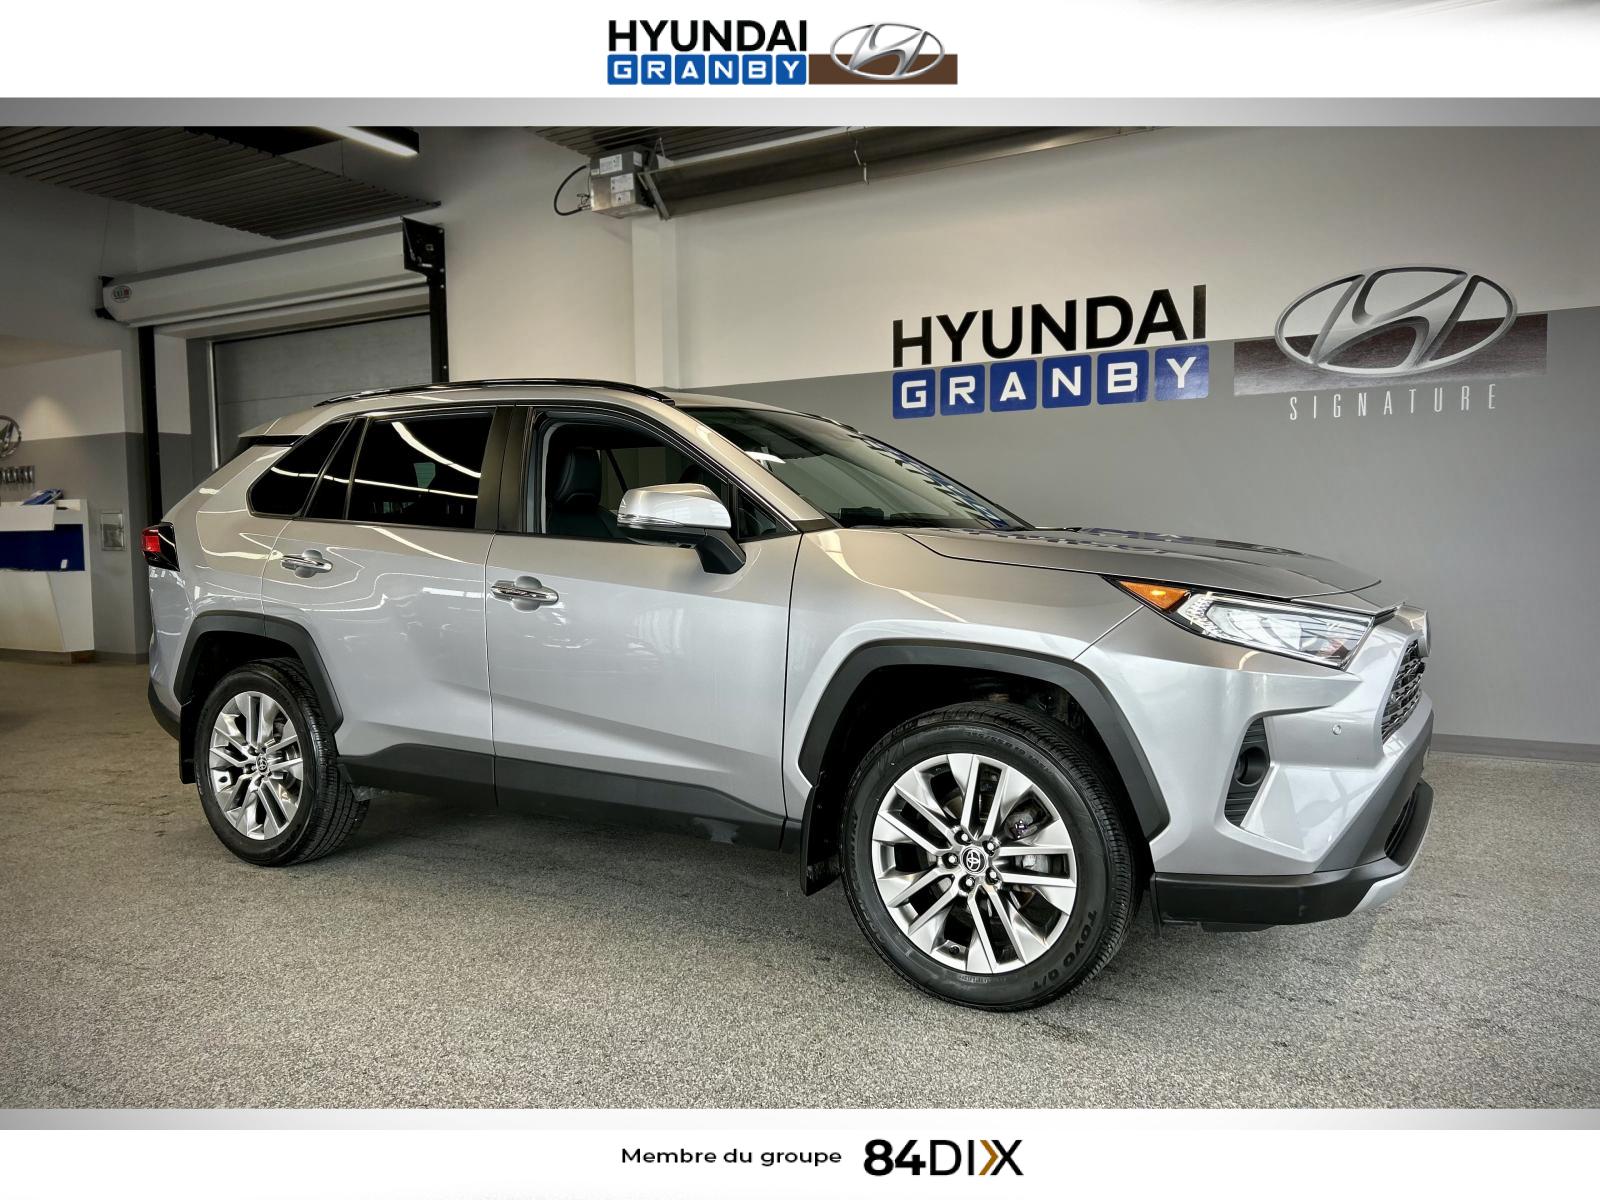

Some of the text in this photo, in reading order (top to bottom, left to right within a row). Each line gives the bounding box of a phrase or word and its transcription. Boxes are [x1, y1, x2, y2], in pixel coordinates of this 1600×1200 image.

[893, 284, 1207, 368] HYUNDAI
[899, 355, 1200, 411] GRANBY
[1289, 383, 1497, 421] SIGNATURE
[1062, 909, 1098, 968] TOYO
